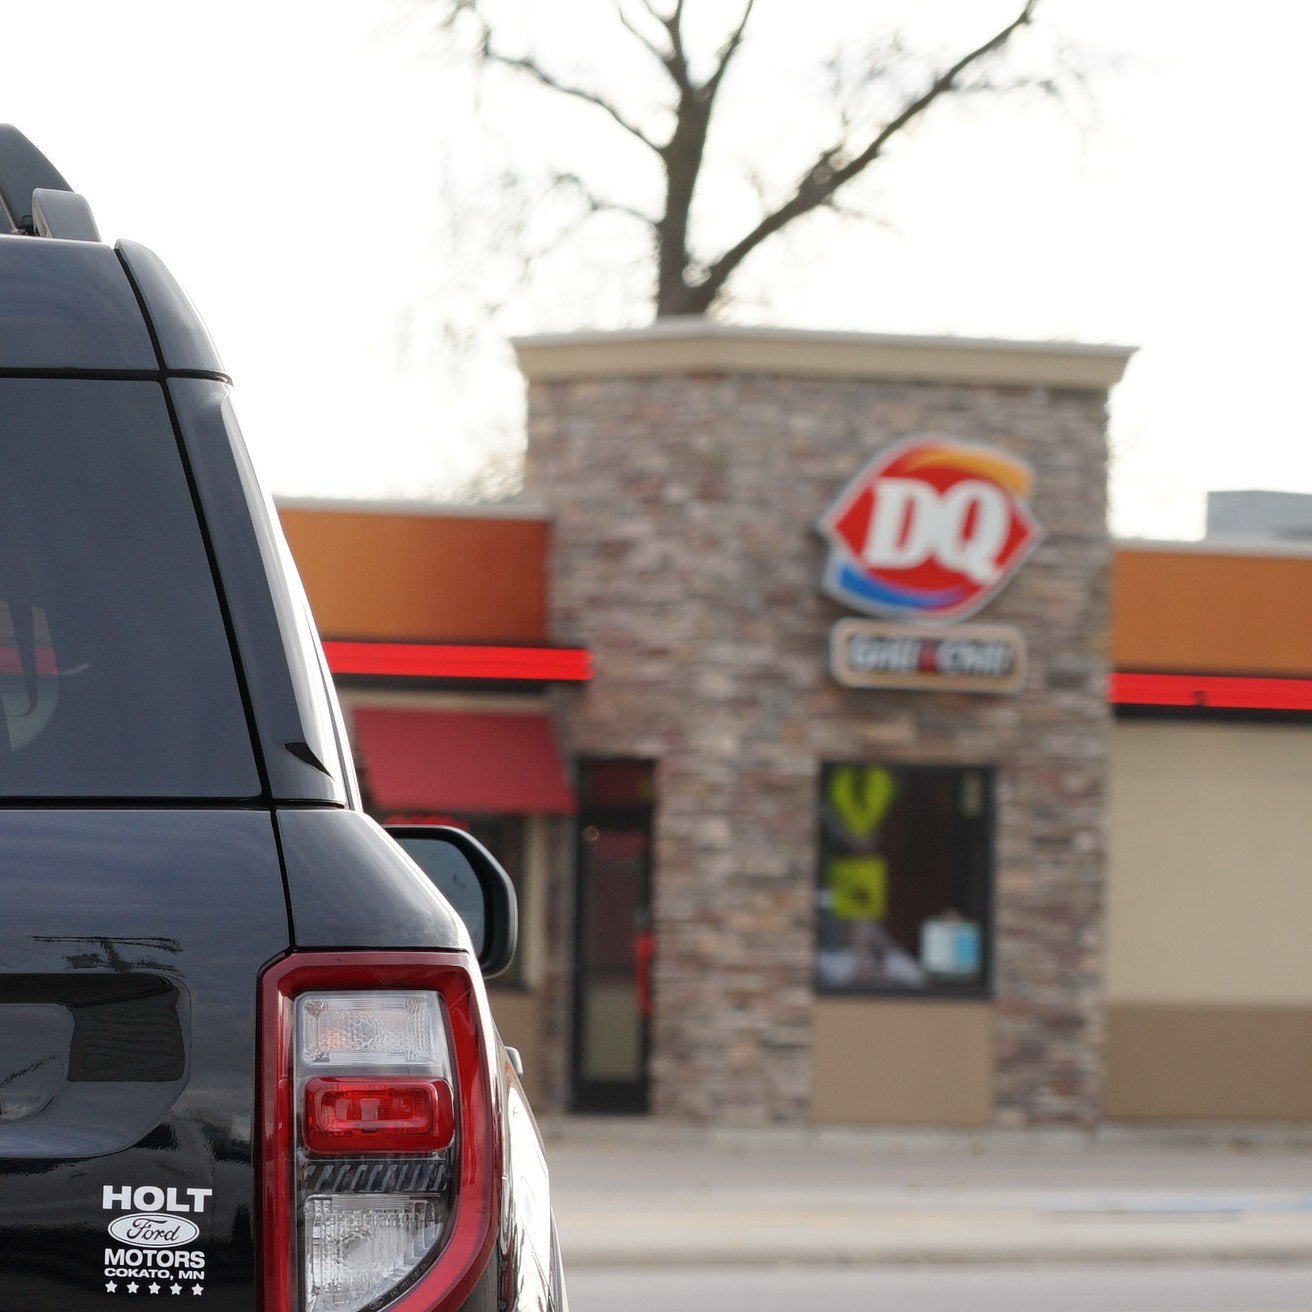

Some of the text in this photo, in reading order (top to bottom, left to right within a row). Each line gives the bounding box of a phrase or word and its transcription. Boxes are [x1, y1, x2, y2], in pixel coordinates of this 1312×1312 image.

[863, 477, 1009, 586] DQ
[102, 1185, 213, 1213] HOLT
[126, 1217, 182, 1242] Ford
[104, 1248, 206, 1269] MOTORS
[104, 1268, 205, 1281] COKATO, MN
